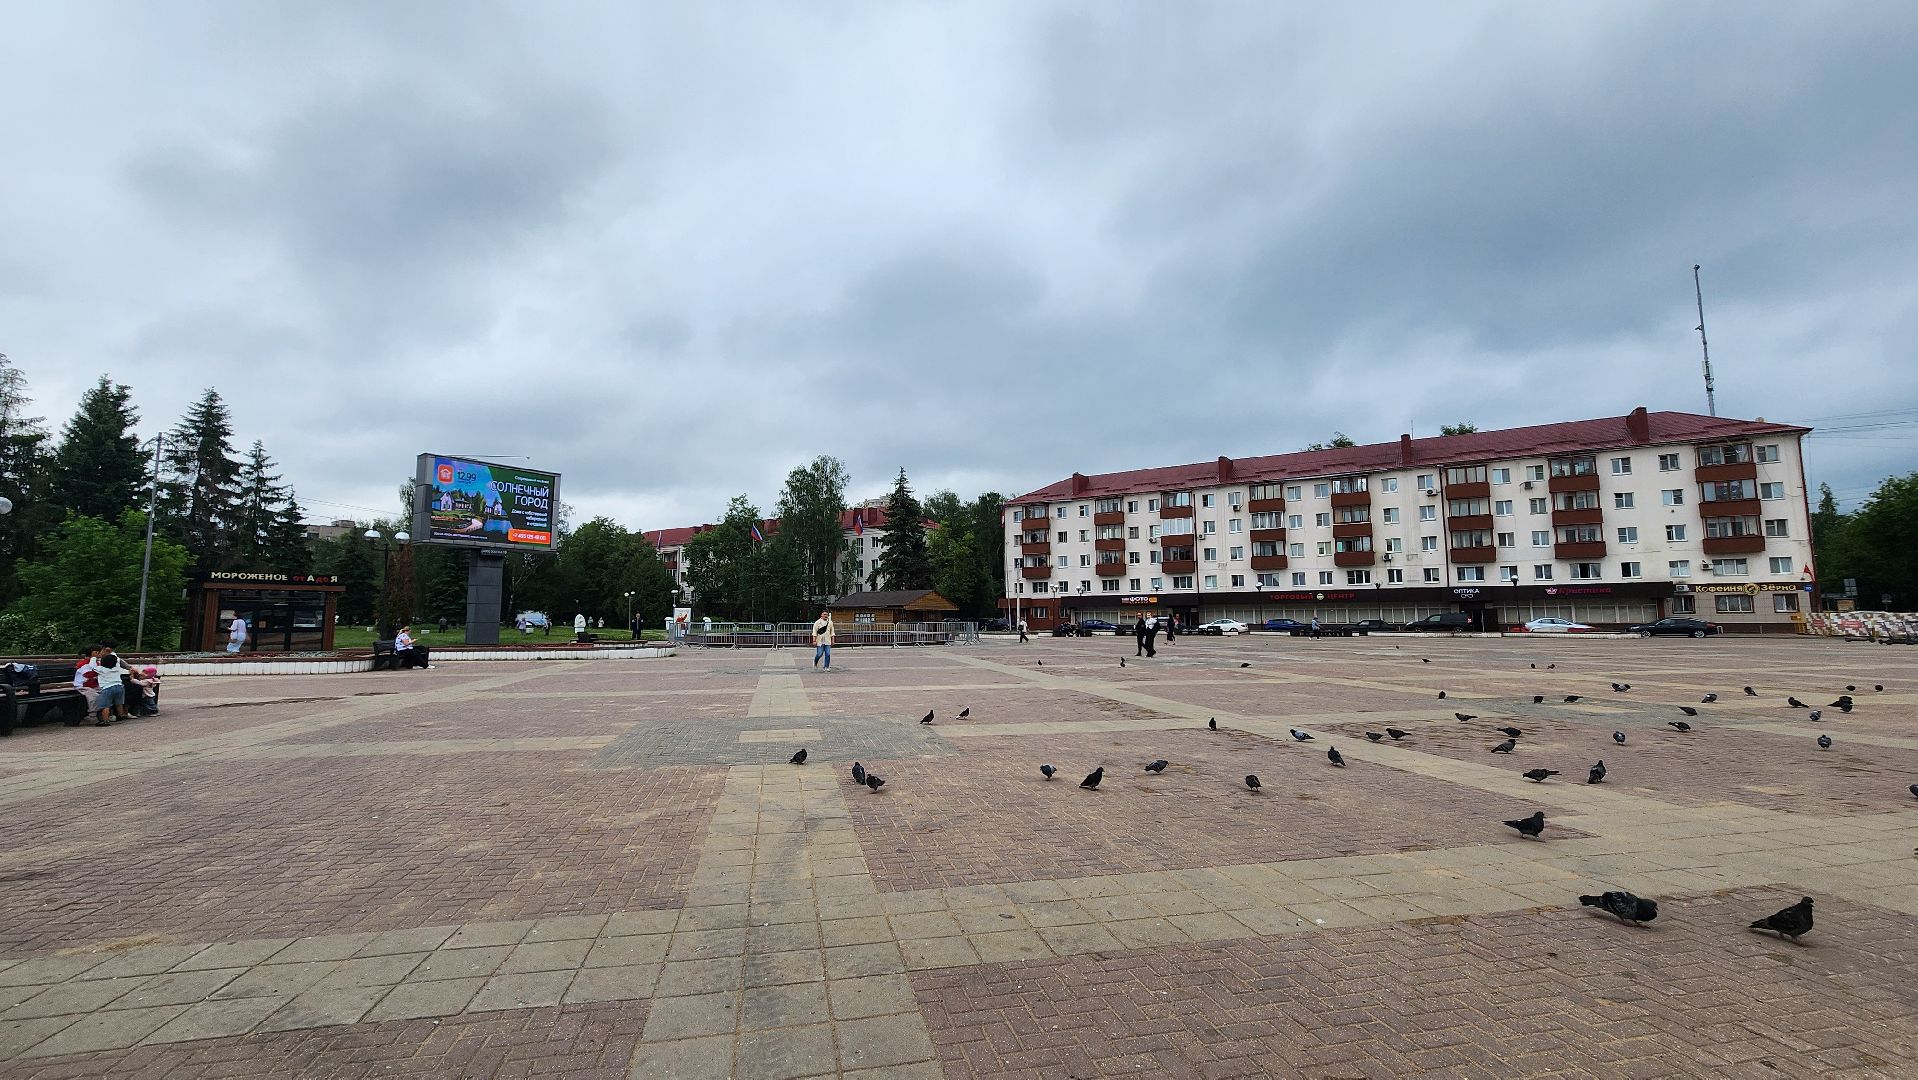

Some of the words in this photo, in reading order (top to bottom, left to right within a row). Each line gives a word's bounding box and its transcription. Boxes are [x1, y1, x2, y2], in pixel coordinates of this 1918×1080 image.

[490, 480, 550, 498] СОЛНЕЧНЫЙ
[514, 495, 549, 510] ГОРОД
[211, 571, 288, 581] МОРОЖЕНОЕ
[330, 575, 338, 583] Я
[1760, 583, 1796, 591] Зёрна
[1270, 592, 1314, 600] ТОРГОВЫЙ
